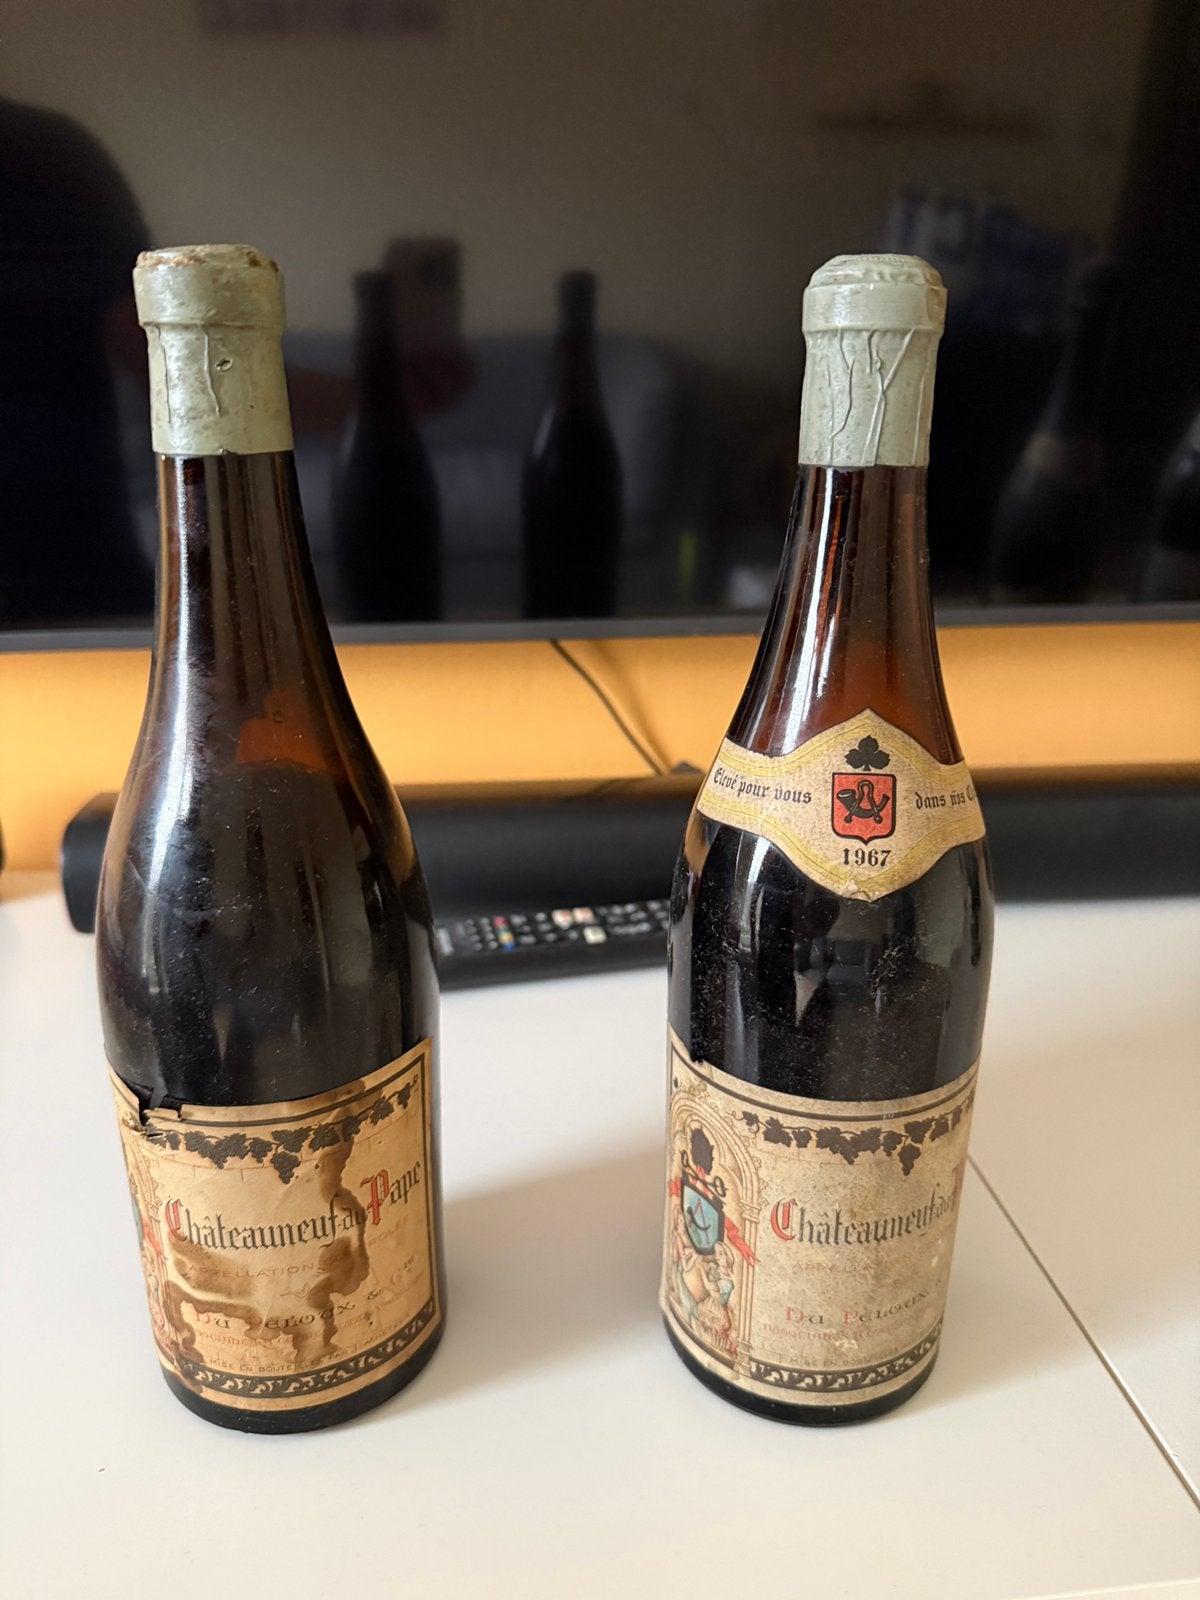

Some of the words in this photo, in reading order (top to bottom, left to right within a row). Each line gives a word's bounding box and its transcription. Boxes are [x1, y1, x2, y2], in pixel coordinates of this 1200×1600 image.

[737, 780, 770, 798] pour
[774, 787, 812, 804] vous
[914, 791, 946, 810] dans
[843, 848, 892, 867] 1967
